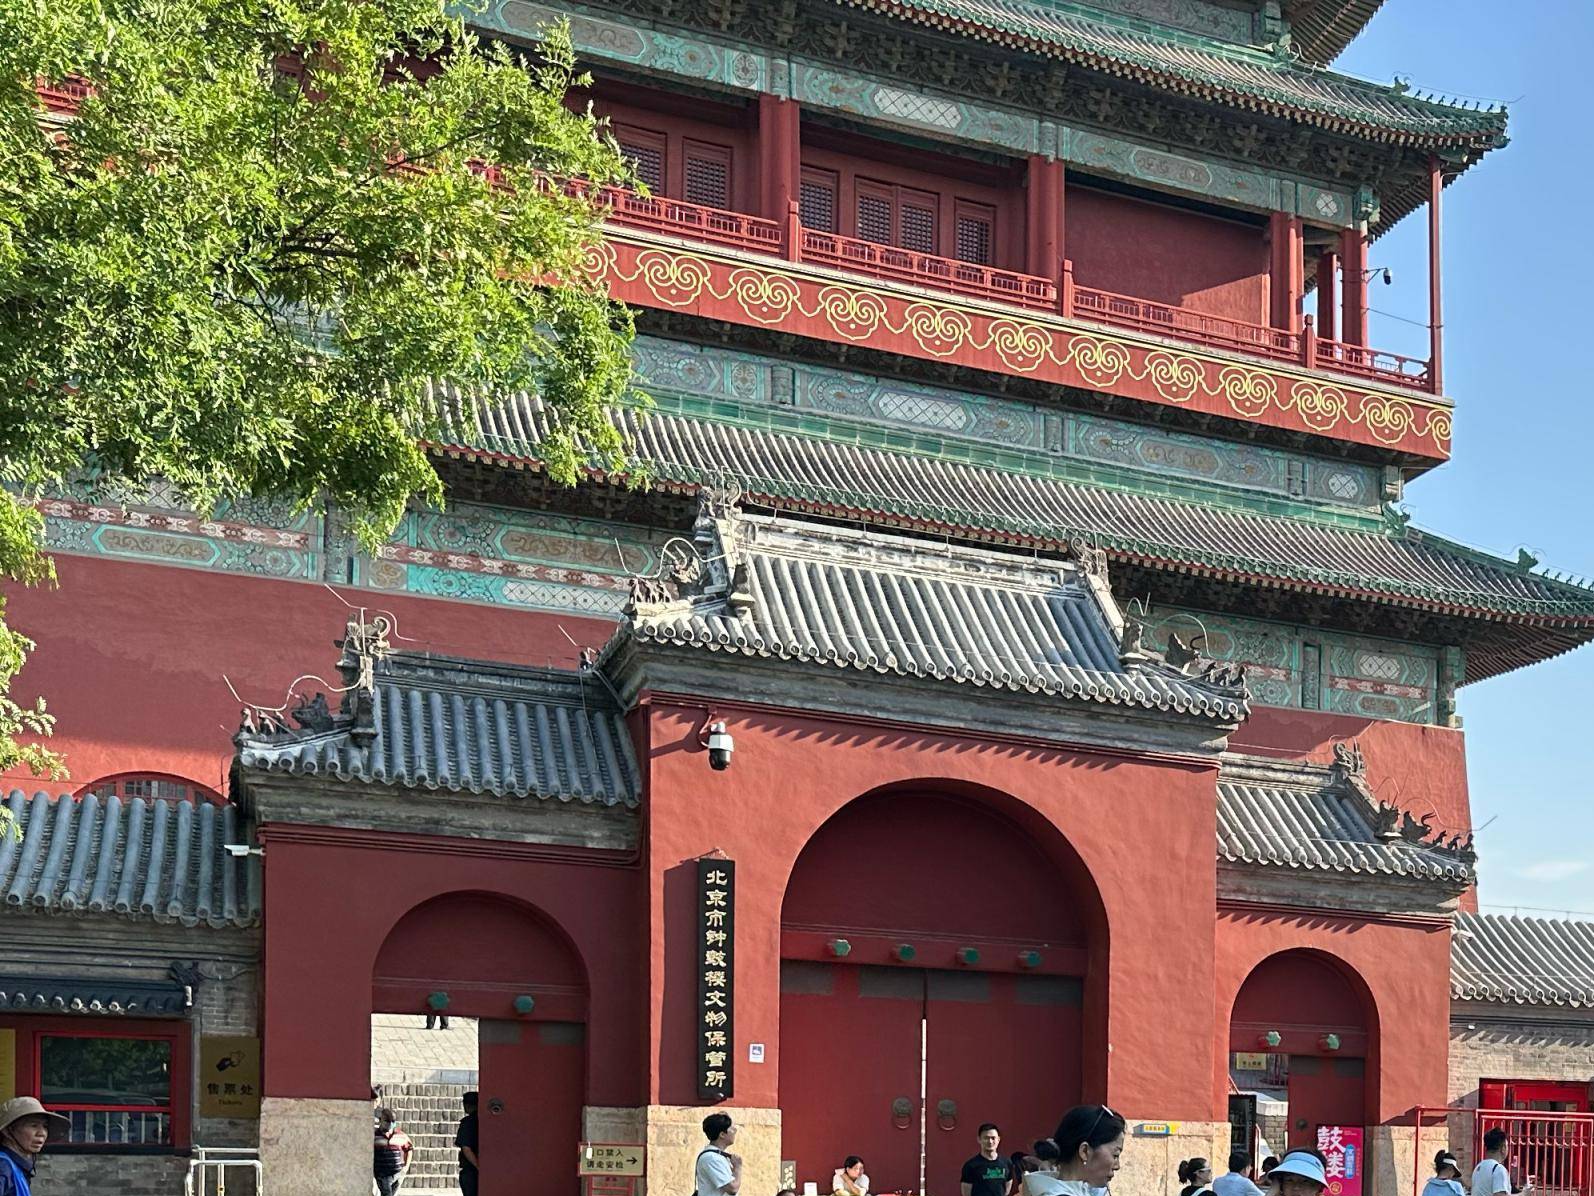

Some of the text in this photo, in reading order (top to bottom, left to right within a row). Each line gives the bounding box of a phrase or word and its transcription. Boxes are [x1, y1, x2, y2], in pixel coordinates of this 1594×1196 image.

[207, 1082, 253, 1096] 售票处
[588, 1149, 624, 1157] 口禁入
